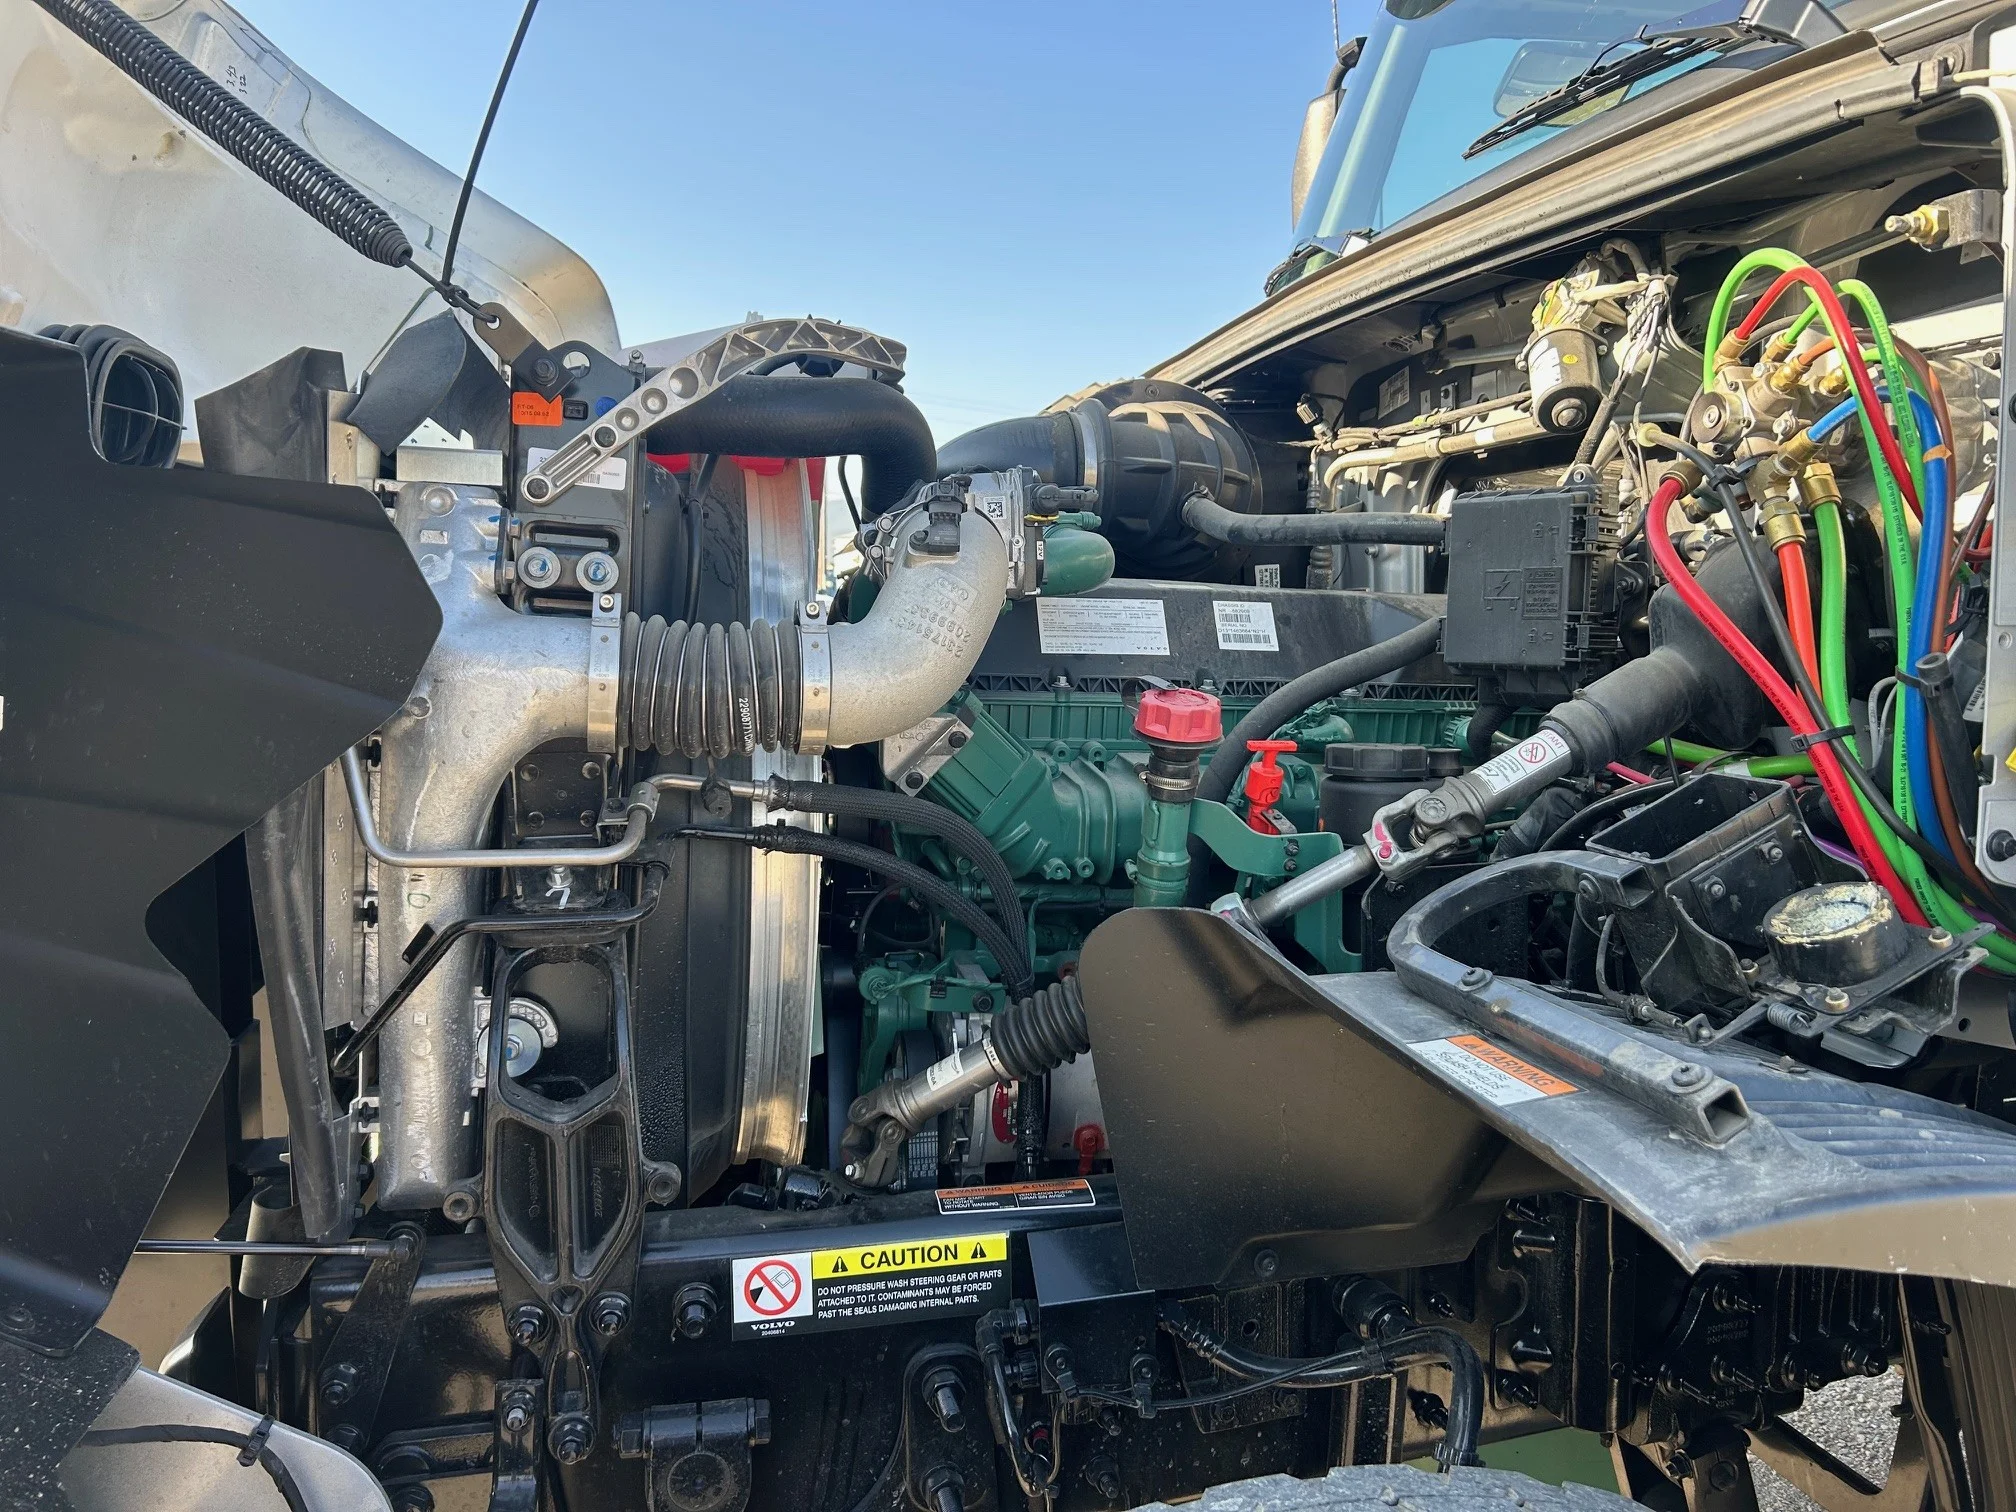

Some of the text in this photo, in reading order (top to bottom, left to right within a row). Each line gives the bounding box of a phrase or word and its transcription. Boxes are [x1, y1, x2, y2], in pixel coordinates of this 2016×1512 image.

[1476, 1048, 1555, 1086] WARNING
[954, 1186, 1002, 1194] WARNING
[860, 1243, 958, 1269] CAUTION
[817, 1269, 1003, 1296] DO NOT PRESSURE WASH STEERING GEAR OR PARTS
[817, 1282, 992, 1308] ATTACHED TO IT. CONTAMINANTS MAY BE FORCED
[818, 1294, 980, 1319] PAST THE SEALS DAMAGING INTERNAL PARTS.
[750, 1320, 795, 1331] VOLVO
